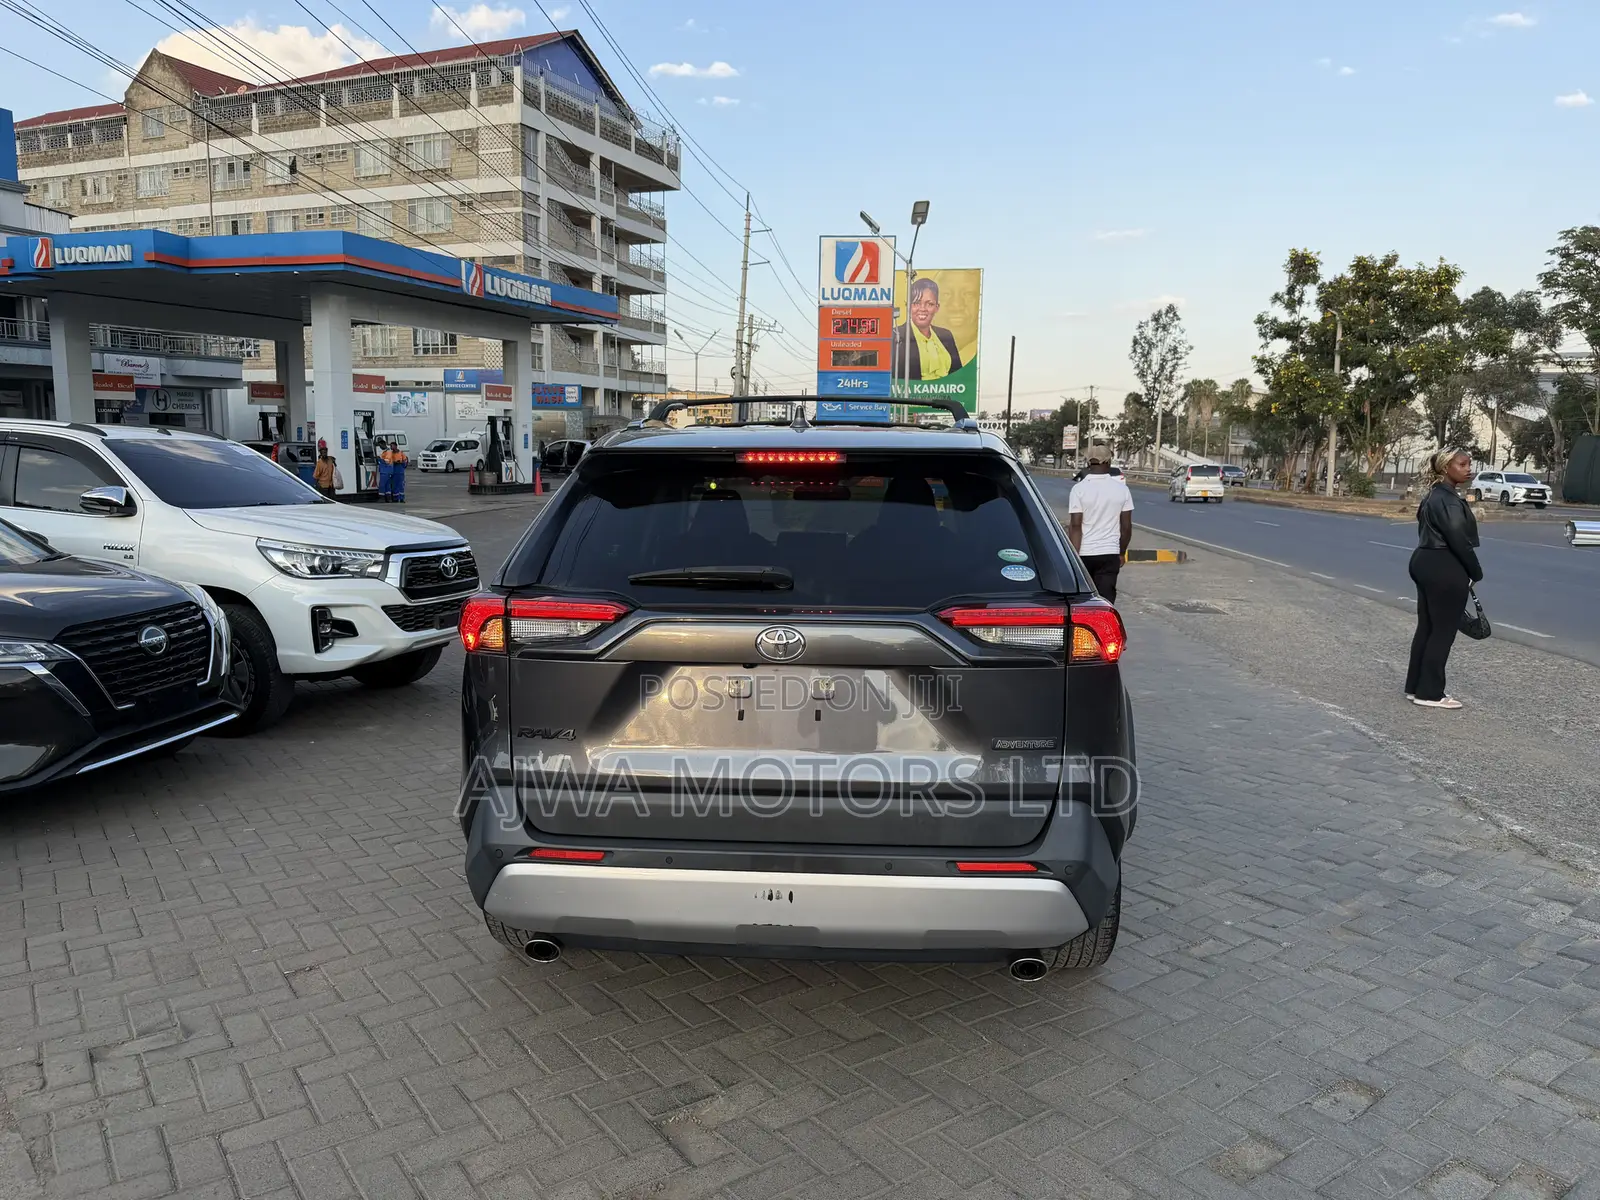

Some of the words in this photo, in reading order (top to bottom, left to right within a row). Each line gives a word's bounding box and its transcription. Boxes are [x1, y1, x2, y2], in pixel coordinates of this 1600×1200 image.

[54, 244, 133, 264] LUQMAN
[485, 273, 552, 306] LUQMAN
[821, 287, 892, 301] LUQMAN
[831, 308, 852, 316] Diesel
[837, 378, 869, 389] 24Hrs
[913, 383, 966, 394] KANAIRO
[171, 402, 200, 410] CHEMIST
[874, 404, 887, 413] Bay
[103, 543, 135, 551] HILUX
[516, 726, 577, 741] RAV4
[995, 740, 1055, 749] ADVENTURE
